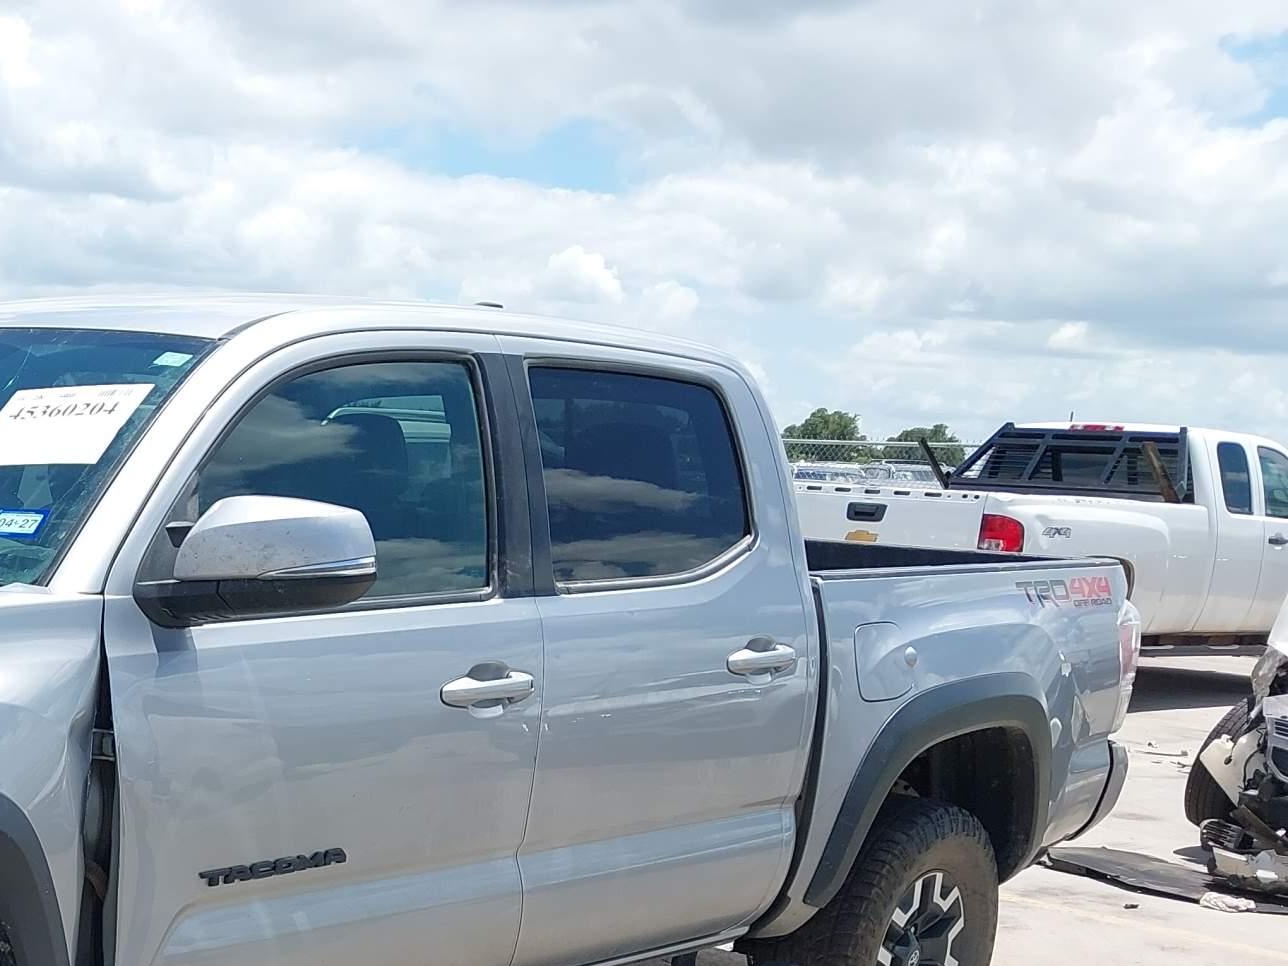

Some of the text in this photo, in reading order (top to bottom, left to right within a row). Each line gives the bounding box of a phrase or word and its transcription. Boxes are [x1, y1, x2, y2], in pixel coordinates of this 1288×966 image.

[9, 401, 120, 420] 45360204
[1015, 579, 1070, 608] TRD
[1073, 597, 1112, 607] OFF ROAD
[198, 847, 348, 887] TACOMA
